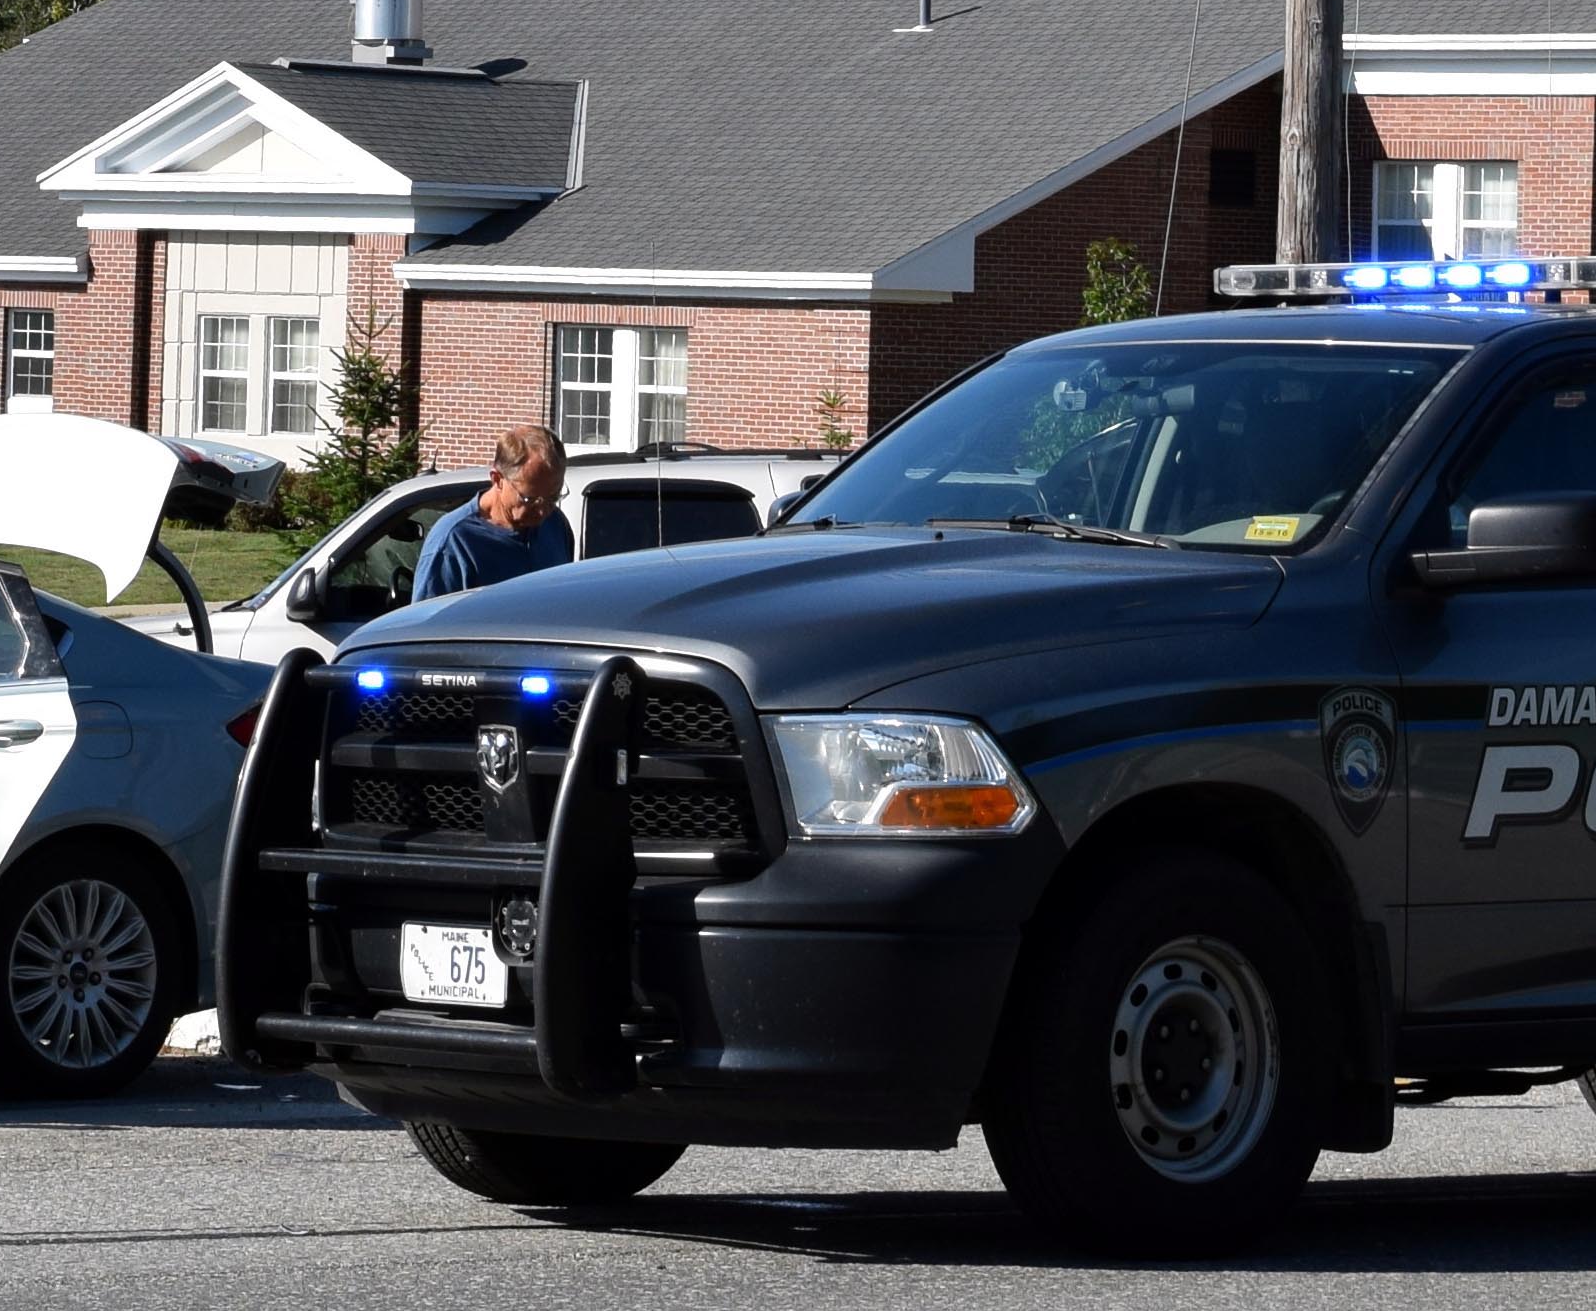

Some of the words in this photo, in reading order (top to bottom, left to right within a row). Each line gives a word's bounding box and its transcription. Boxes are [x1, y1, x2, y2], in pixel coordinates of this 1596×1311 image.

[421, 674, 477, 687] SETINA
[1332, 693, 1383, 717] POLICE
[441, 931, 469, 943] MAINE
[409, 943, 435, 982] POLICE
[450, 945, 486, 985] 675
[428, 984, 480, 1000] MUNICIPAL
